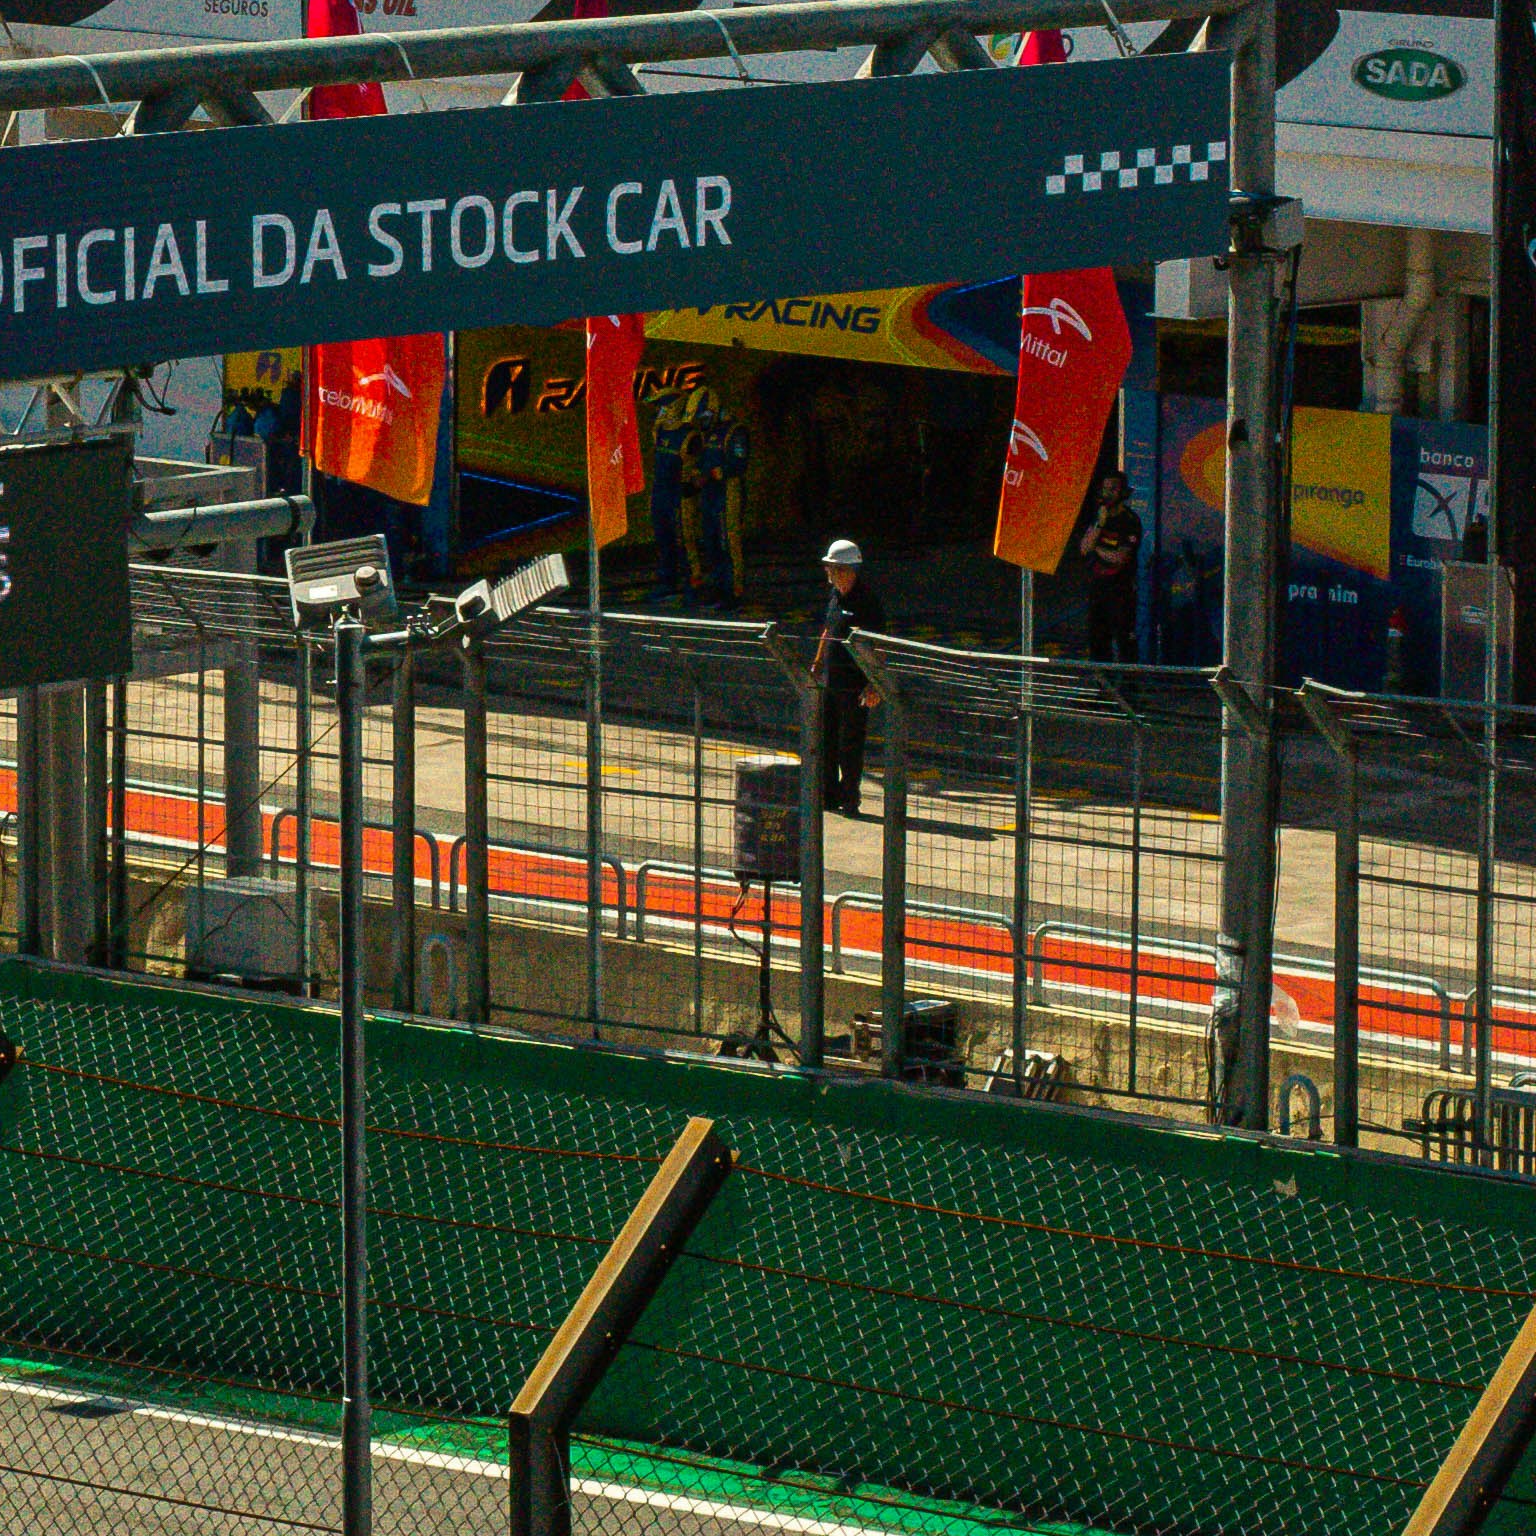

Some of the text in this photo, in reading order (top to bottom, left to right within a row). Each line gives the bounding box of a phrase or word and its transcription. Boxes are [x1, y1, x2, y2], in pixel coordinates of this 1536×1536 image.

[1387, 37, 1434, 49] GRUPO
[1365, 57, 1453, 90] SADA
[252, 208, 348, 288] DA
[366, 185, 587, 278] STOCK
[606, 175, 732, 255] CAR
[723, 298, 882, 335] RACING
[1418, 446, 1475, 468] banco
[1293, 482, 1365, 510] piranga
[1287, 583, 1318, 603] pra
